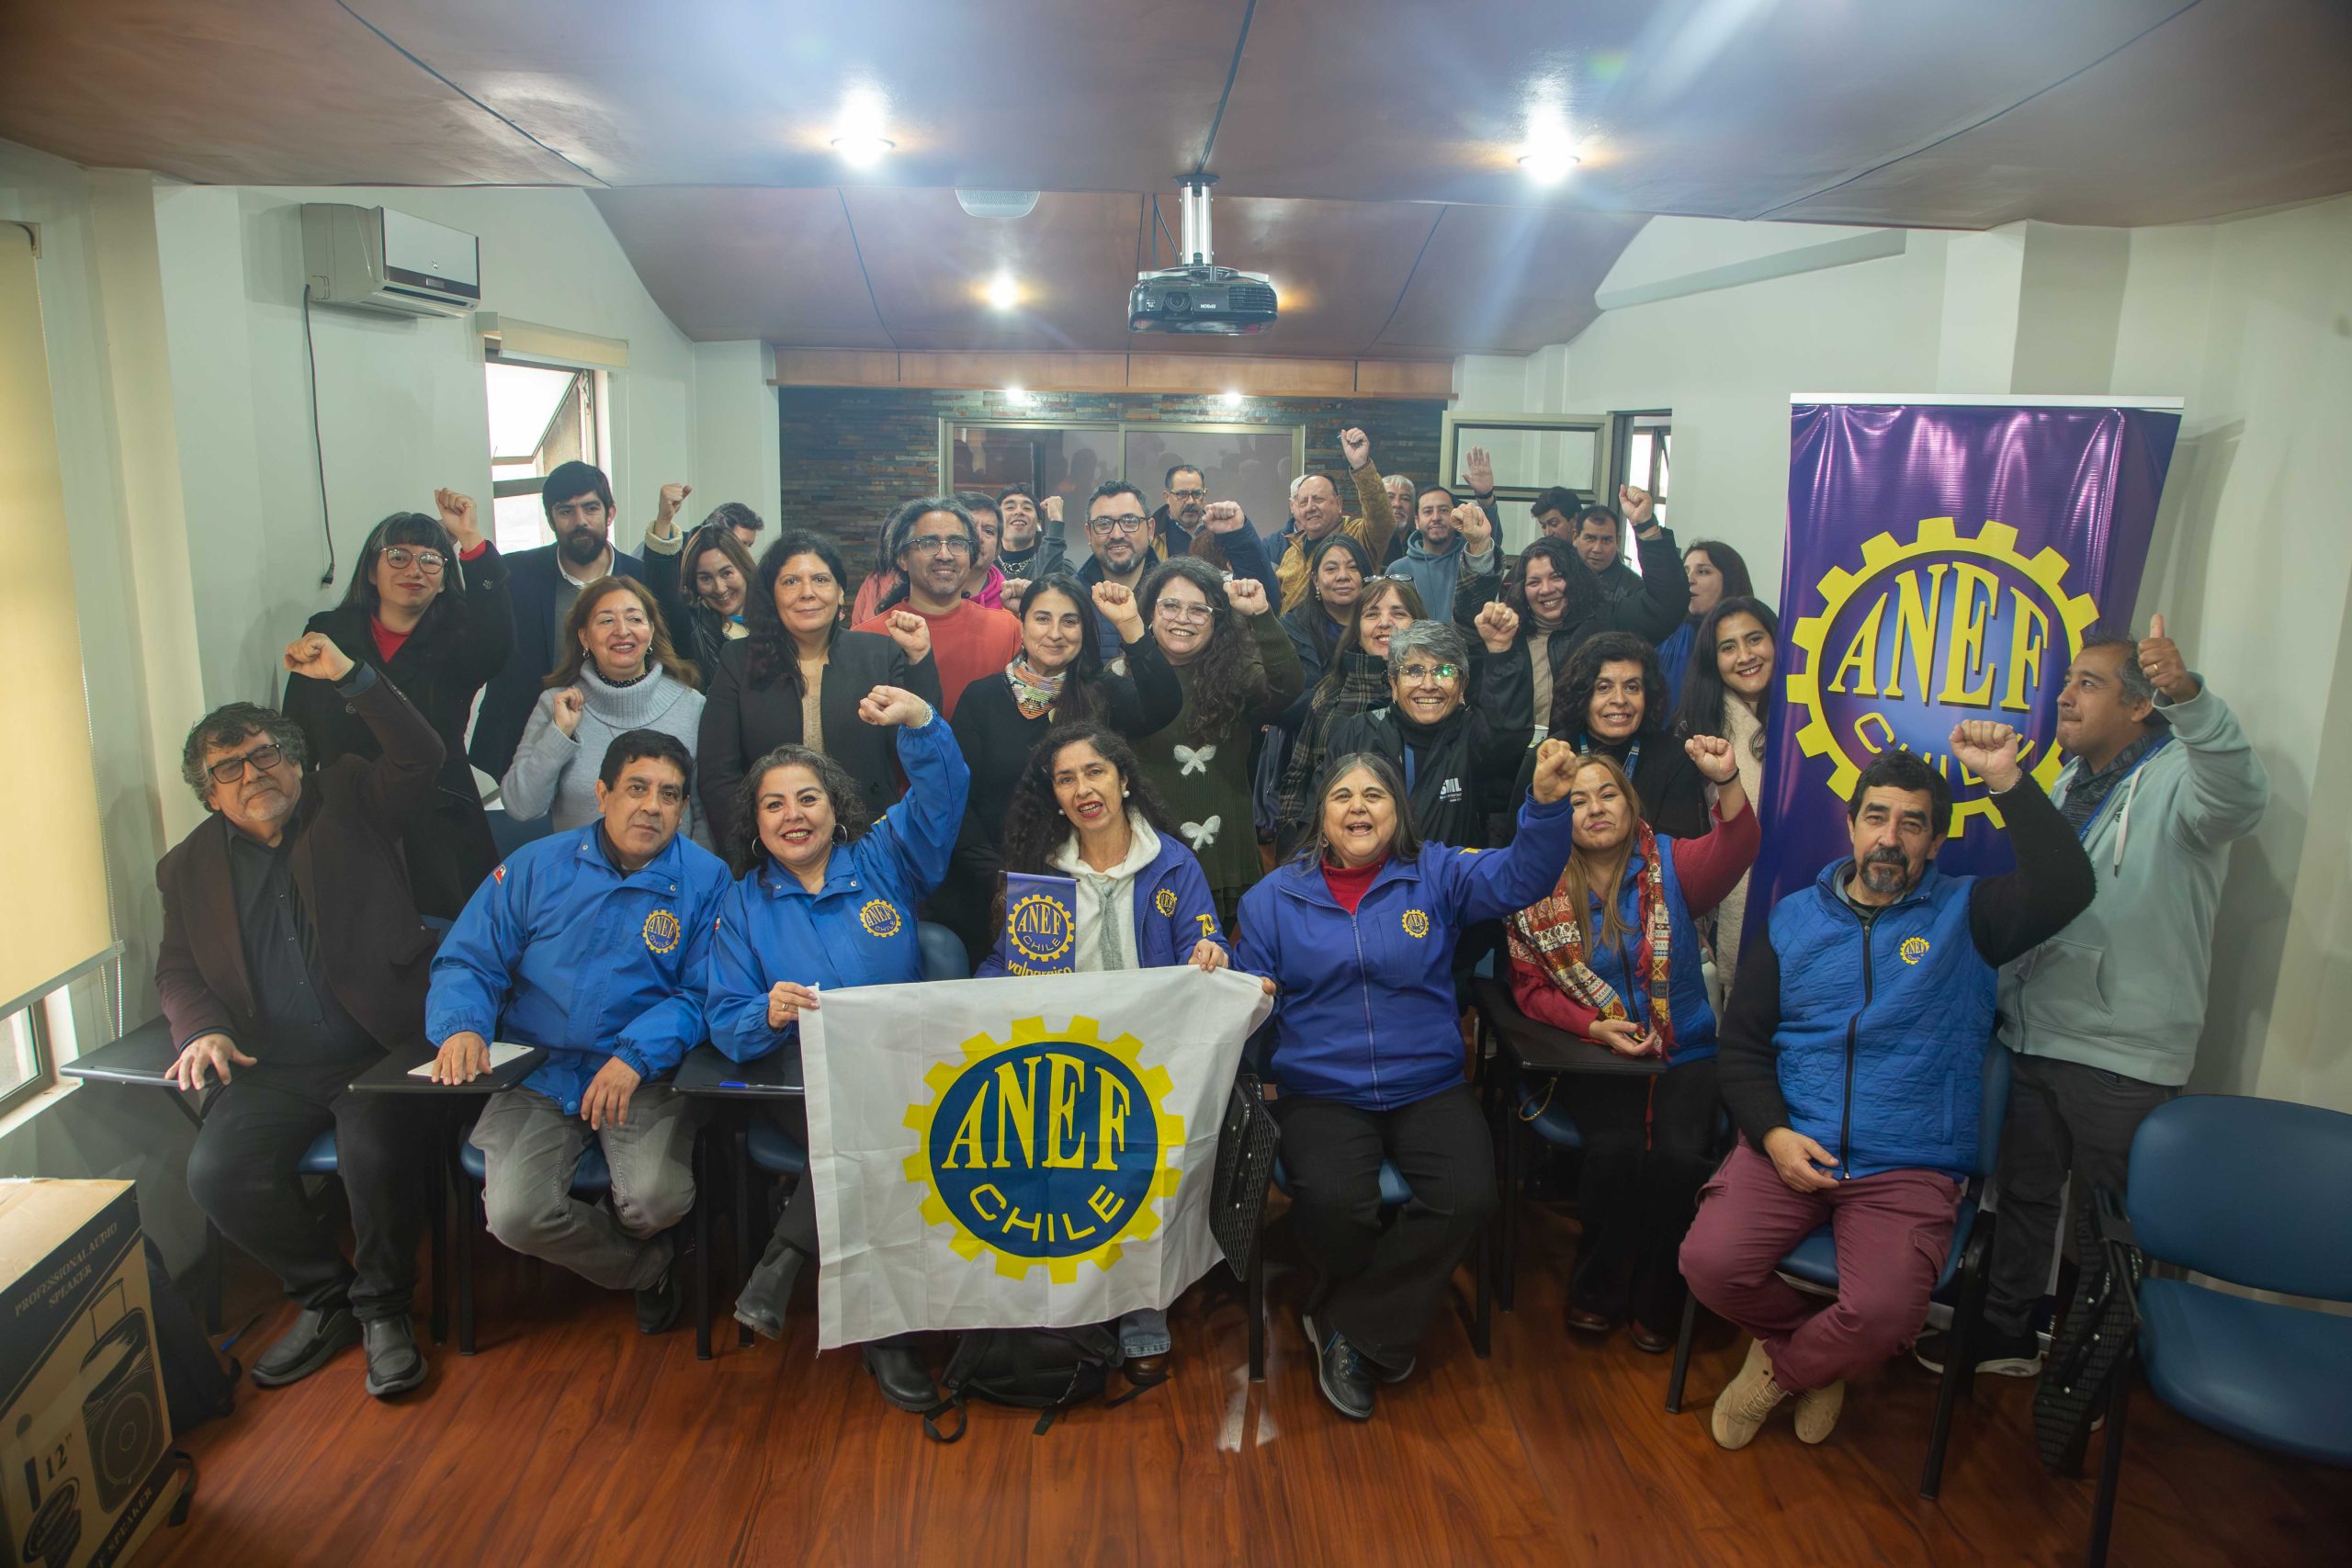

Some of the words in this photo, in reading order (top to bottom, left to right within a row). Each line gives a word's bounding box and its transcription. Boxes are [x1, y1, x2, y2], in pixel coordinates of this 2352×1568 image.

[1827, 560, 2049, 711] ANEF
[647, 916, 676, 938] ANEF
[865, 905, 892, 926] ANEF
[1016, 904, 1062, 935] ANEF
[1023, 935, 1060, 952] CHILE
[941, 1053, 1131, 1171] ANEF
[969, 1183, 1125, 1243] CHILE
[88, 1221, 118, 1255] AUDIO
[48, 1263, 93, 1308] SPEAKER
